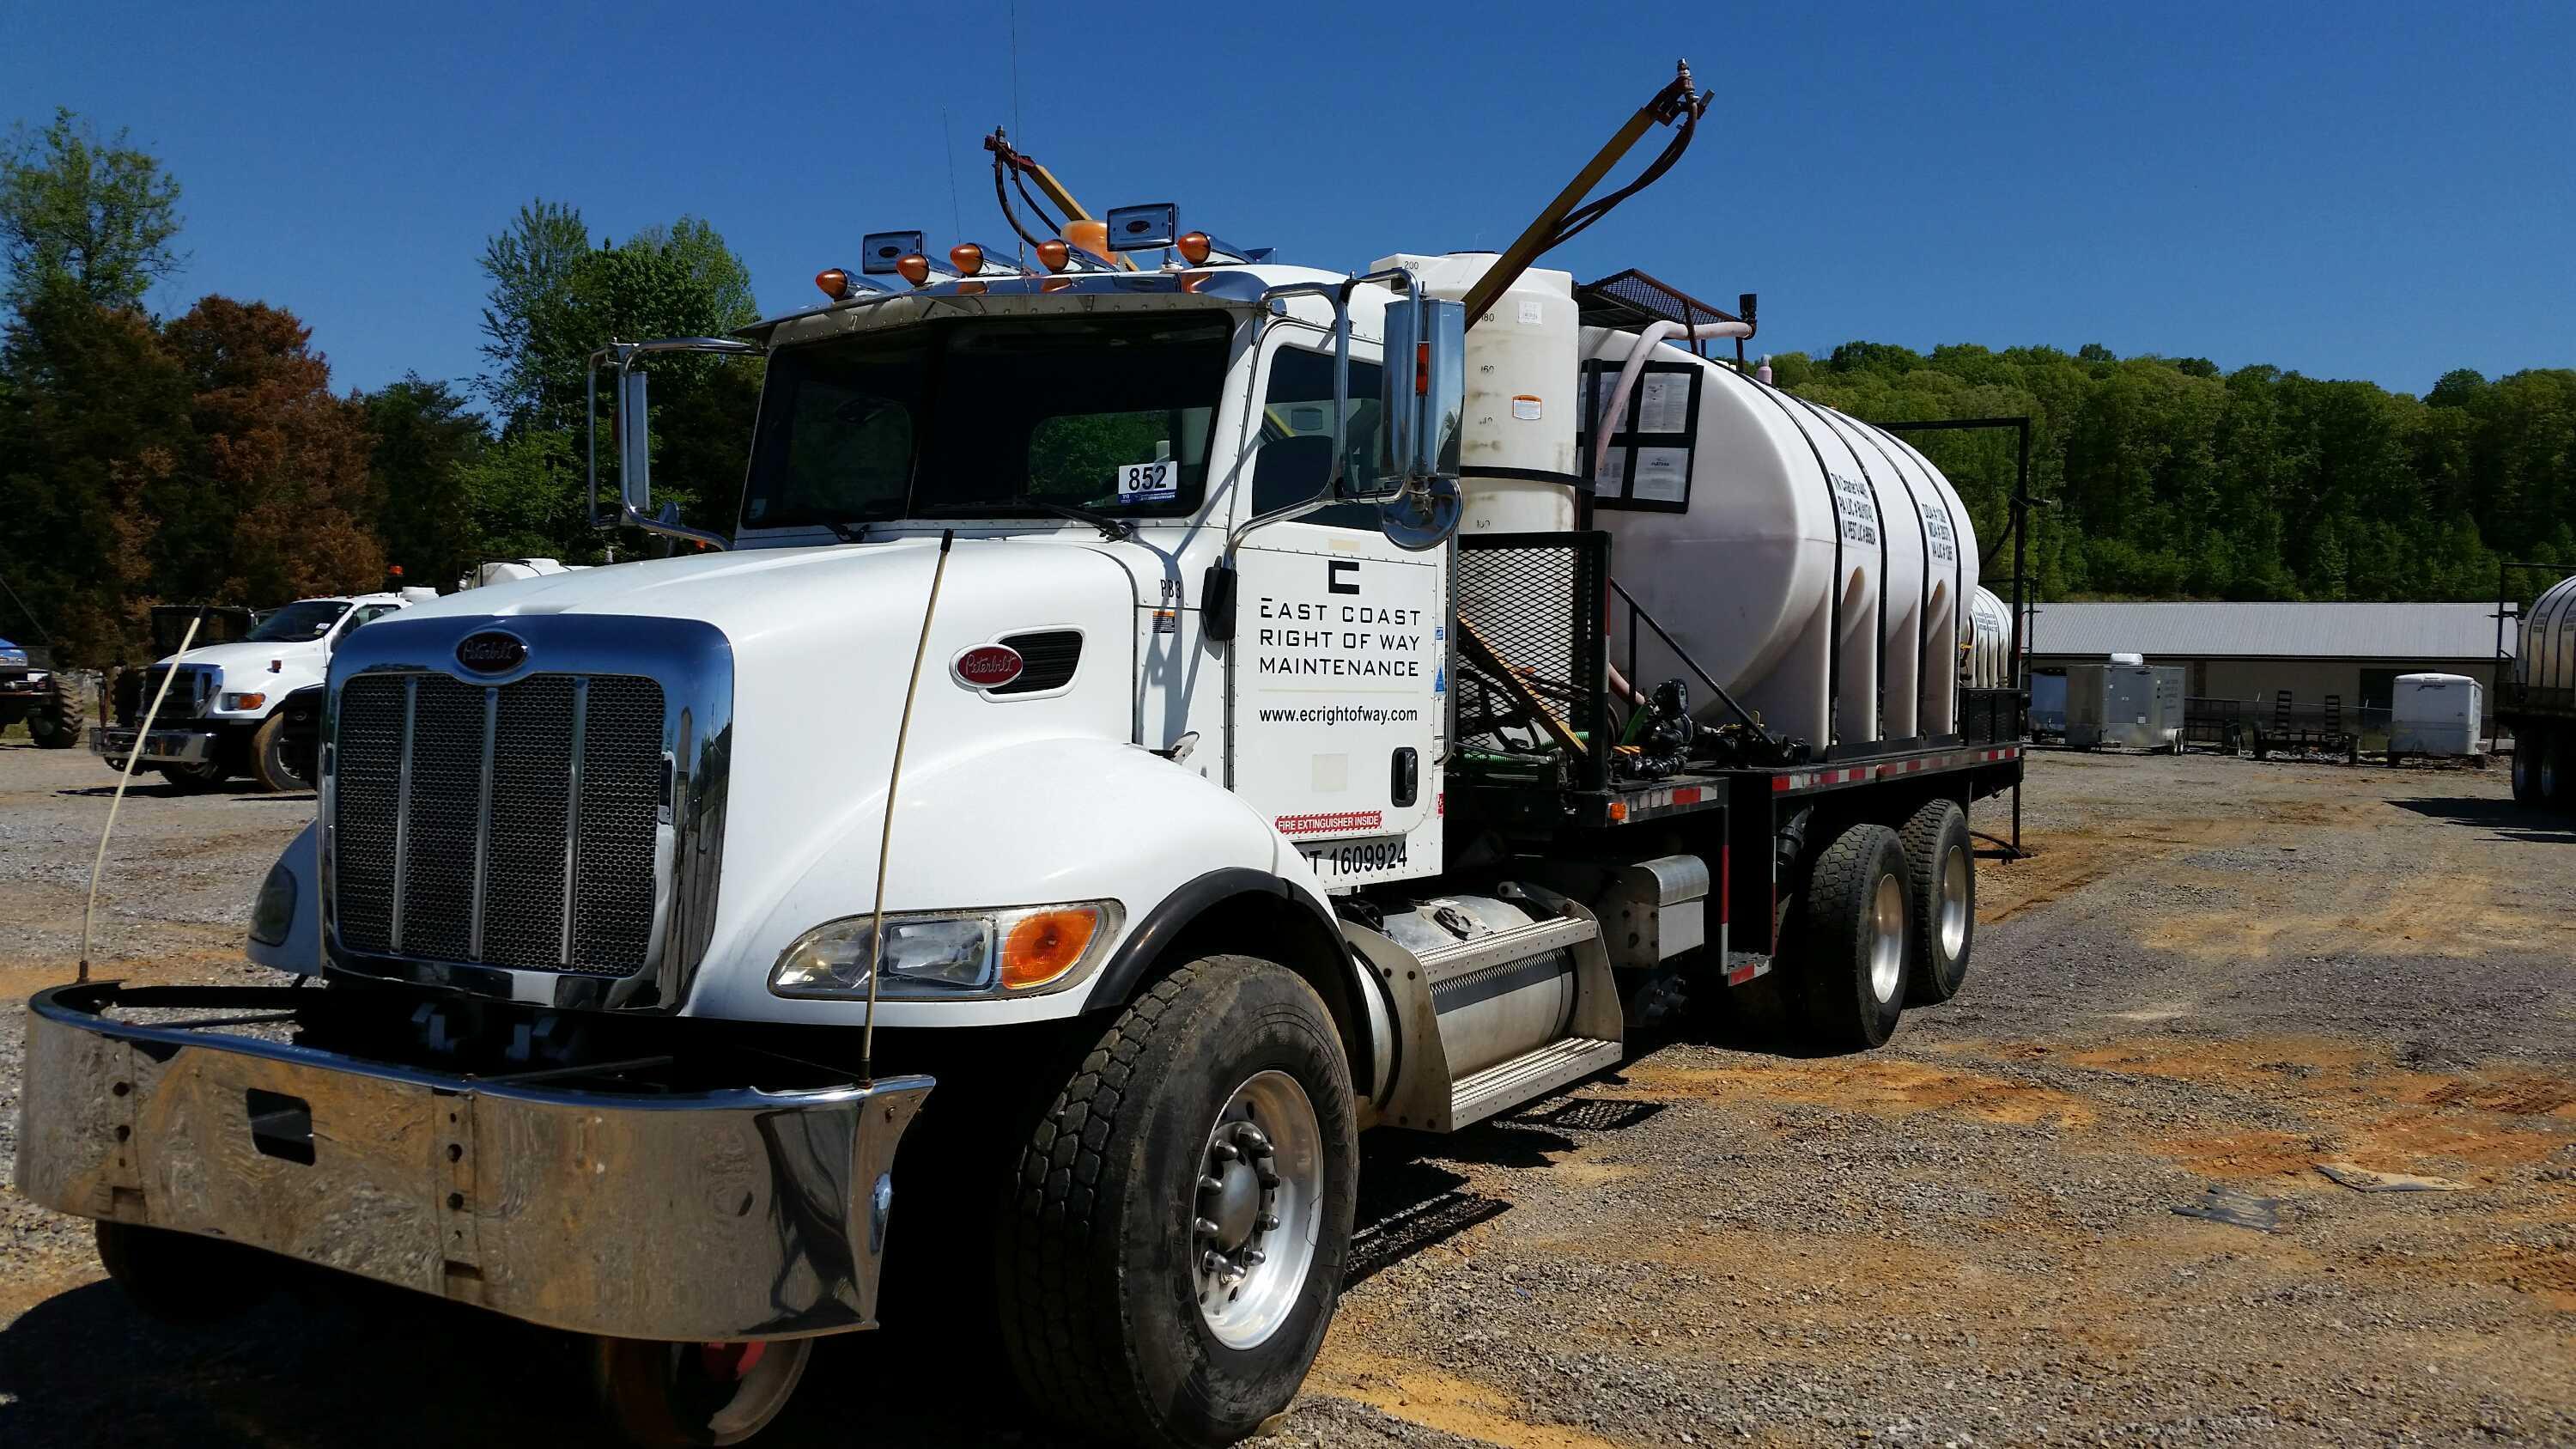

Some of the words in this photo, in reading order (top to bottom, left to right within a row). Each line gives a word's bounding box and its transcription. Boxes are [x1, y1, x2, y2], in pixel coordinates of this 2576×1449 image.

[1404, 260, 1419, 270] 200
[1128, 465, 1167, 491] 852
[1160, 579, 1182, 599] PB3
[1261, 597, 1327, 621] EAST
[1342, 606, 1421, 626] COAST
[1260, 629, 1333, 648] RIGHT
[1343, 632, 1371, 649] OF
[1380, 634, 1420, 651] WAY
[965, 654, 1018, 675] Peterbilt
[1259, 656, 1419, 677] MAINTENANCE
[1259, 705, 1418, 726] www.ecrightofway.com
[1278, 819, 1296, 831] FIRE
[1297, 817, 1354, 830] EXTINGUISHER
[1354, 815, 1379, 826] INSIDE
[1331, 840, 1407, 876] 1609924
